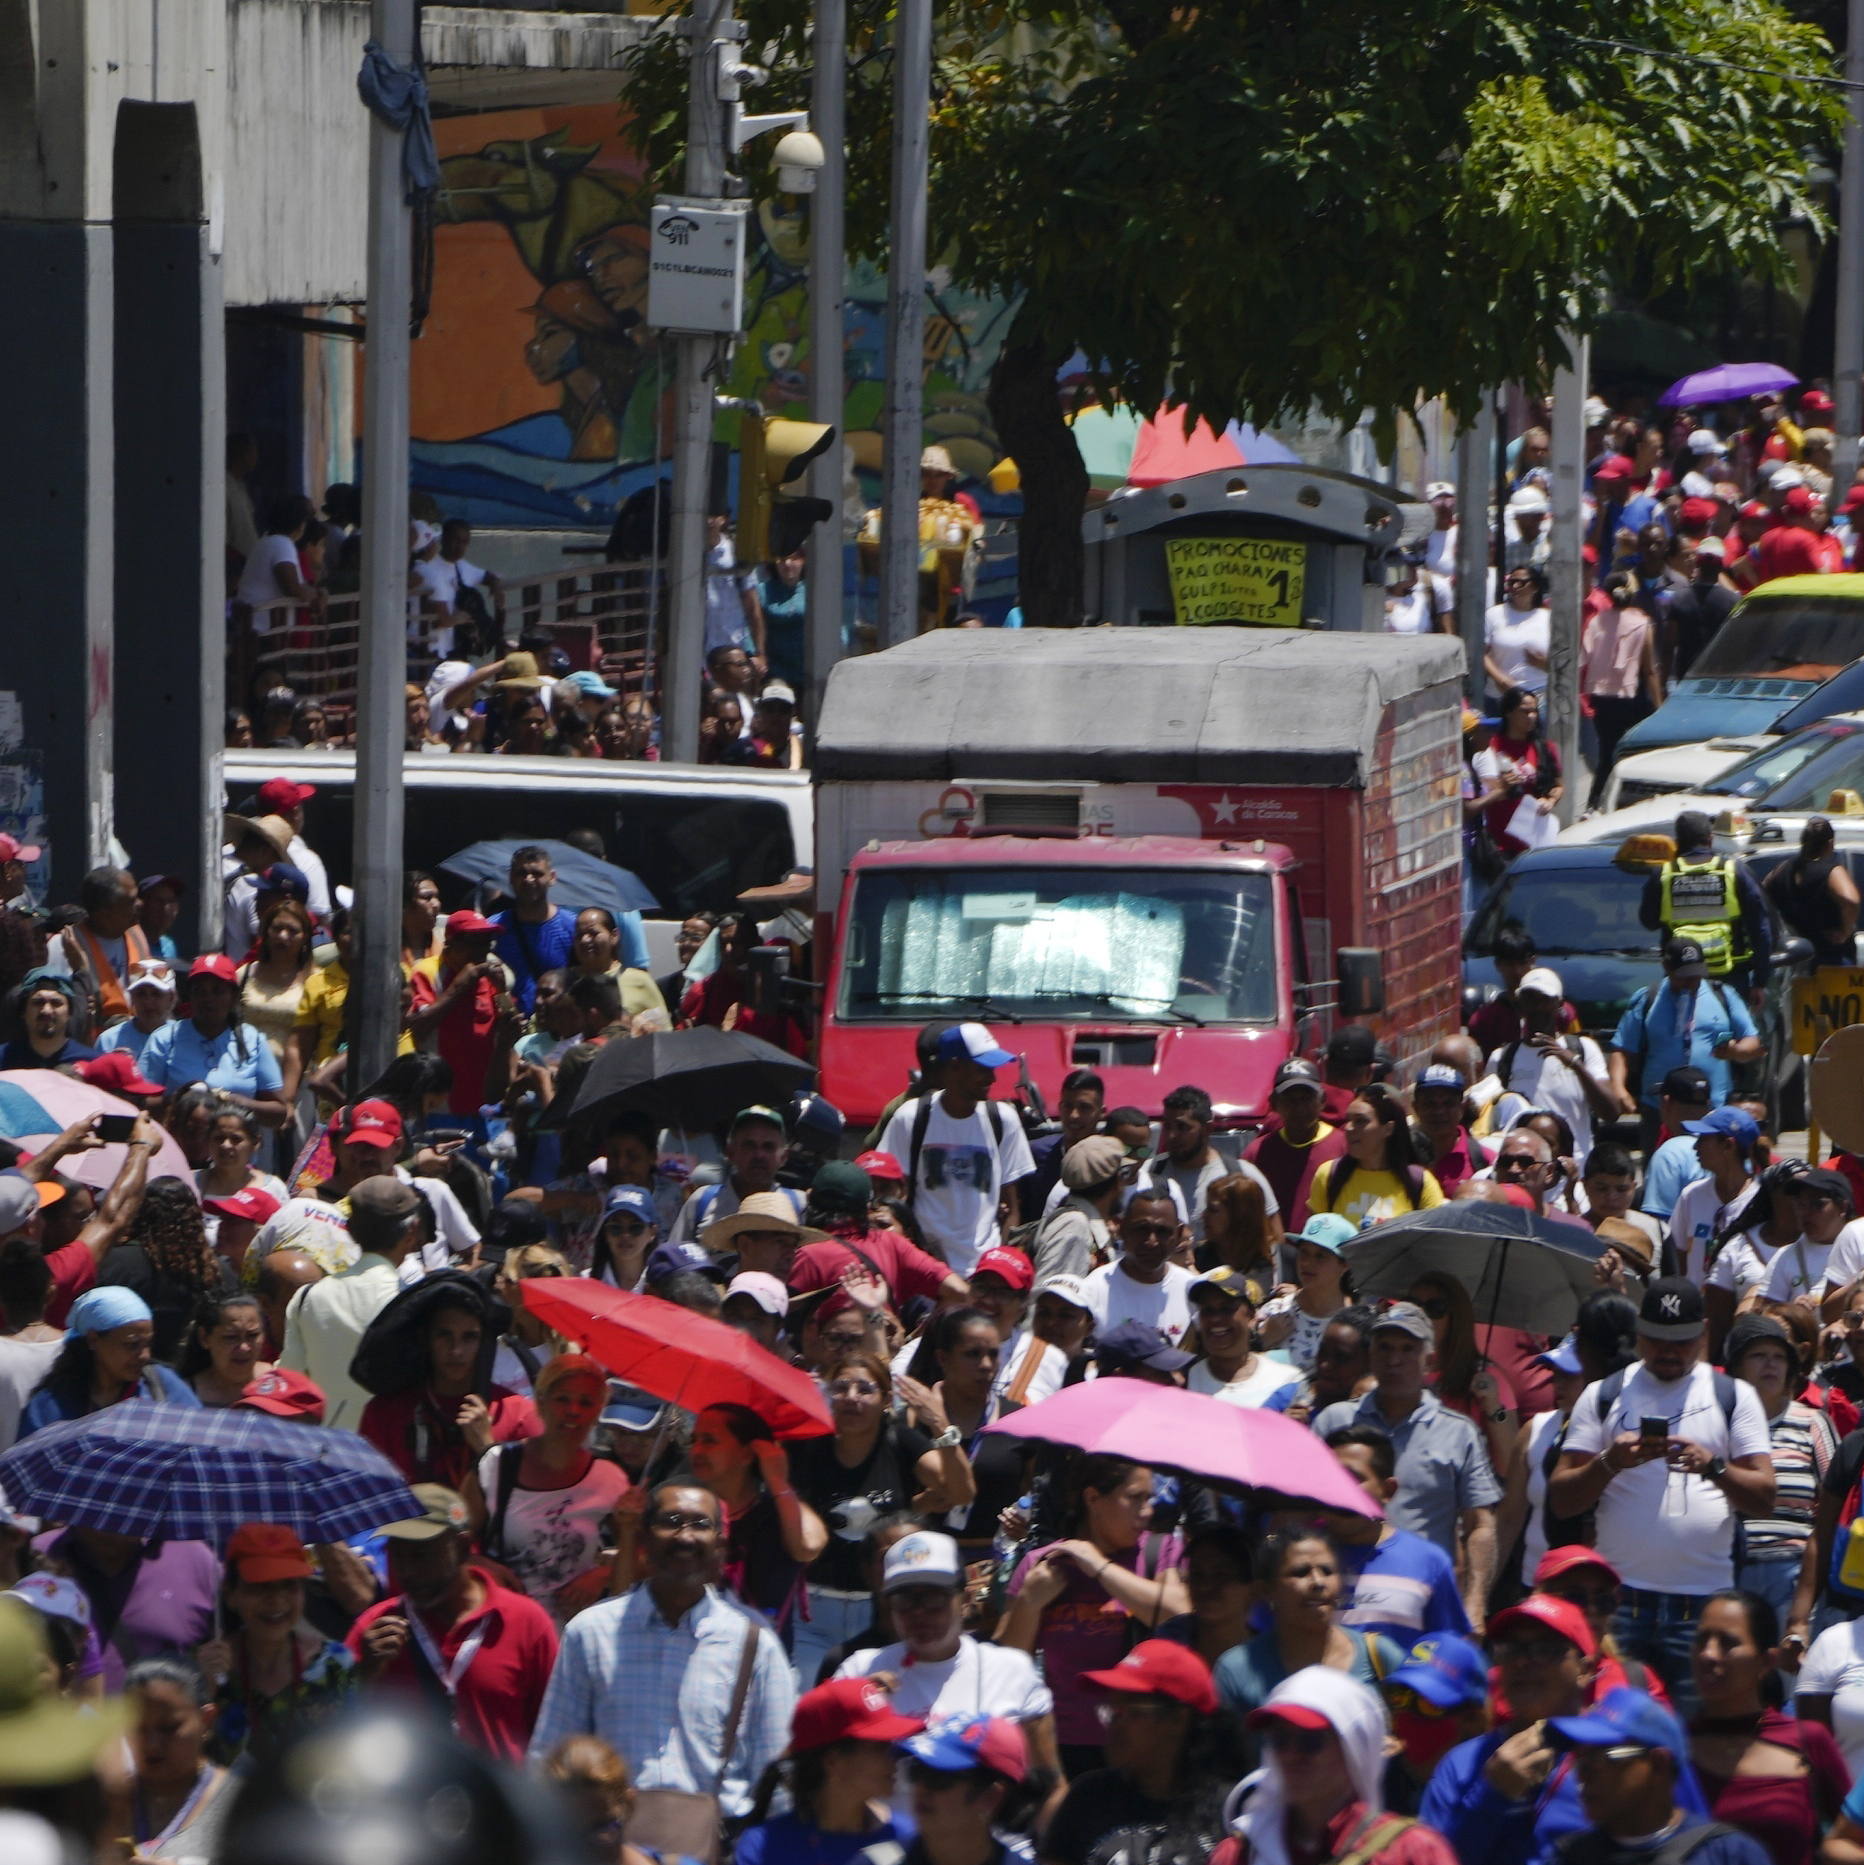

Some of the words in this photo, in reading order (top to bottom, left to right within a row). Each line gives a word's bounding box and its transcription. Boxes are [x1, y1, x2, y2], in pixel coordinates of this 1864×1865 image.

[669, 232, 689, 245] 911
[1168, 541, 1306, 567] PROMOCIONES
[1257, 810, 1299, 820] Caracas
[1820, 994, 1862, 1029] NO
[1661, 1294, 1681, 1317] NY
